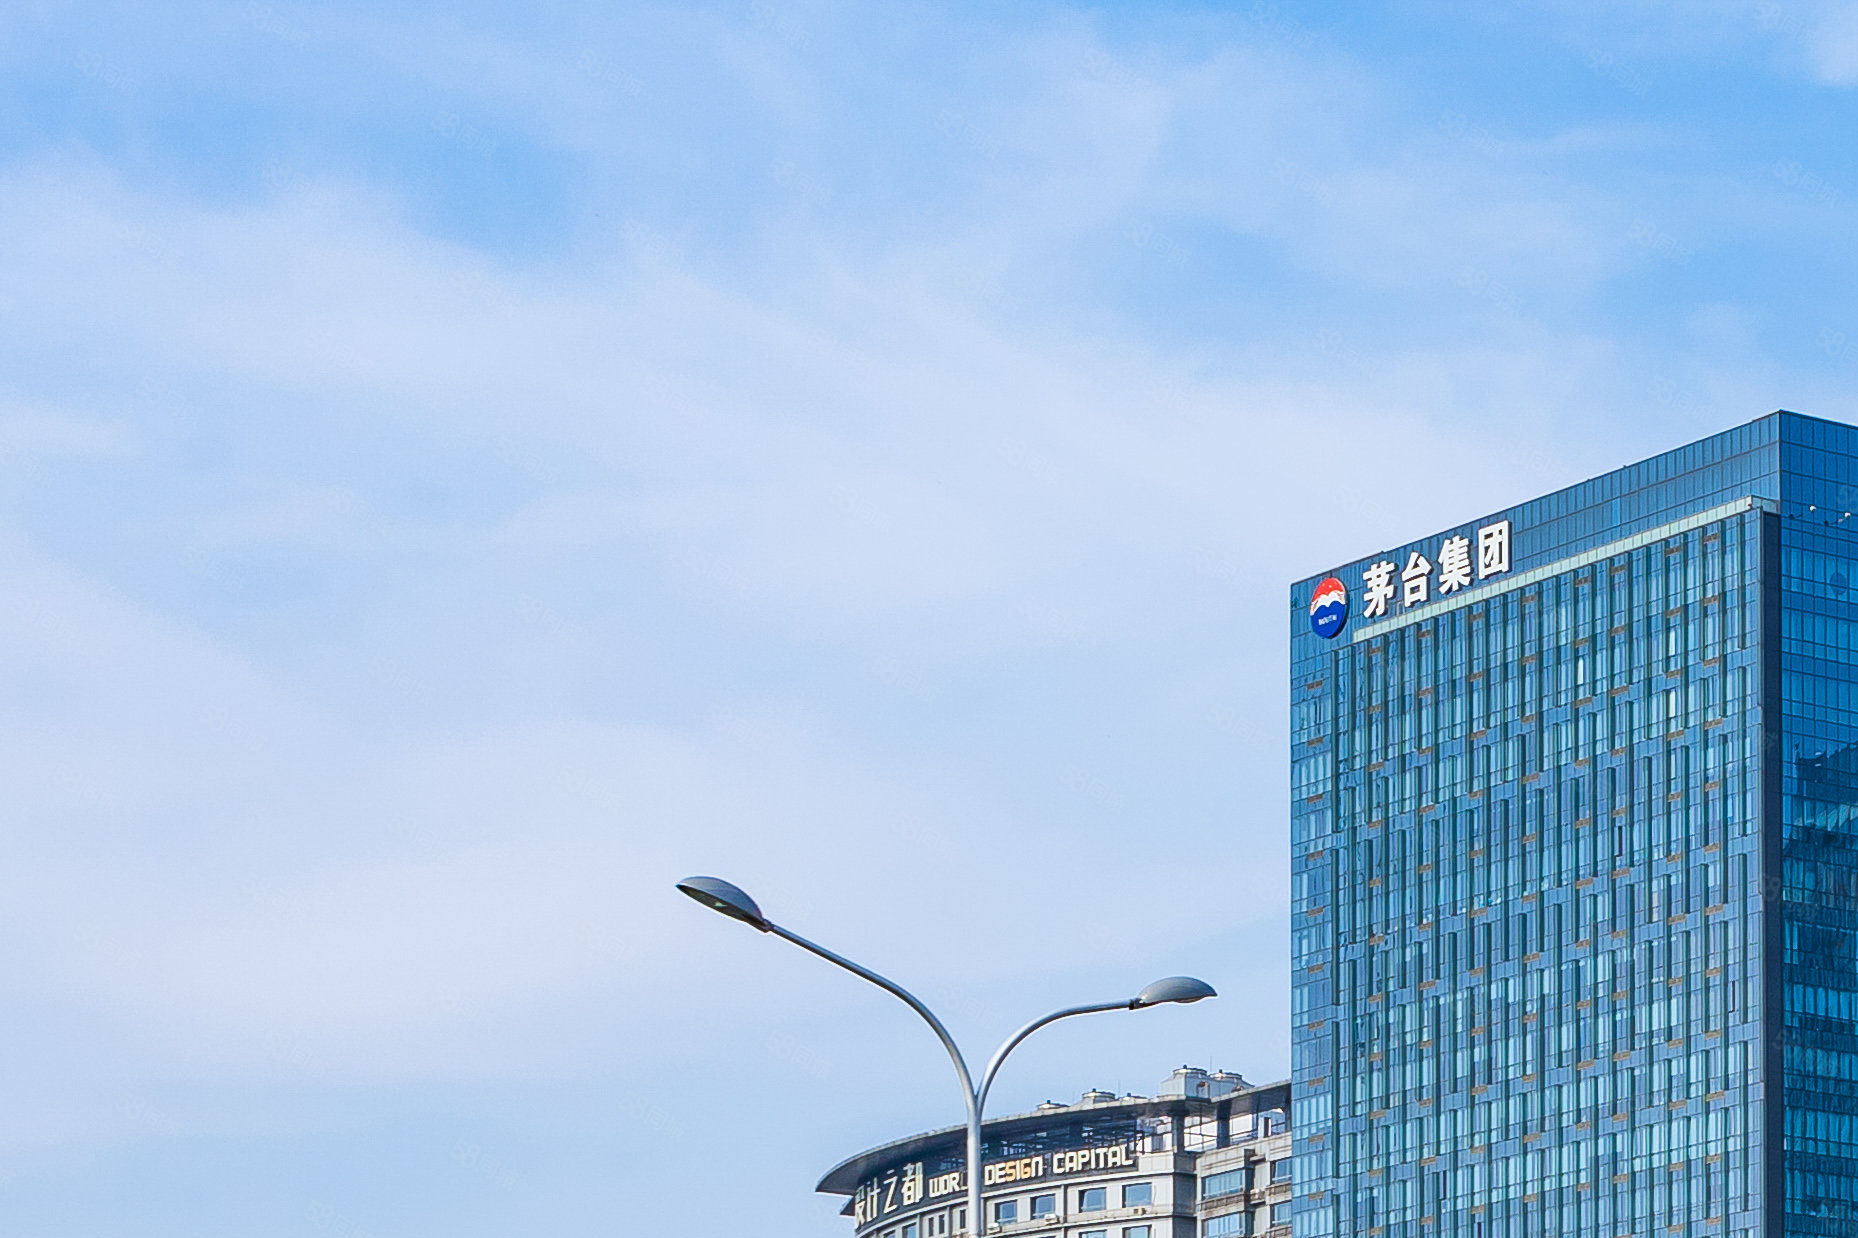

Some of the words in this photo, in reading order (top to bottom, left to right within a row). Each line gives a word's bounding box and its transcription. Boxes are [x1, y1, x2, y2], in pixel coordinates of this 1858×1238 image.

[1362, 520, 1511, 618] 茅台集团
[984, 1155, 1043, 1186] DESIGN
[1053, 1144, 1134, 1174] CAPITAL
